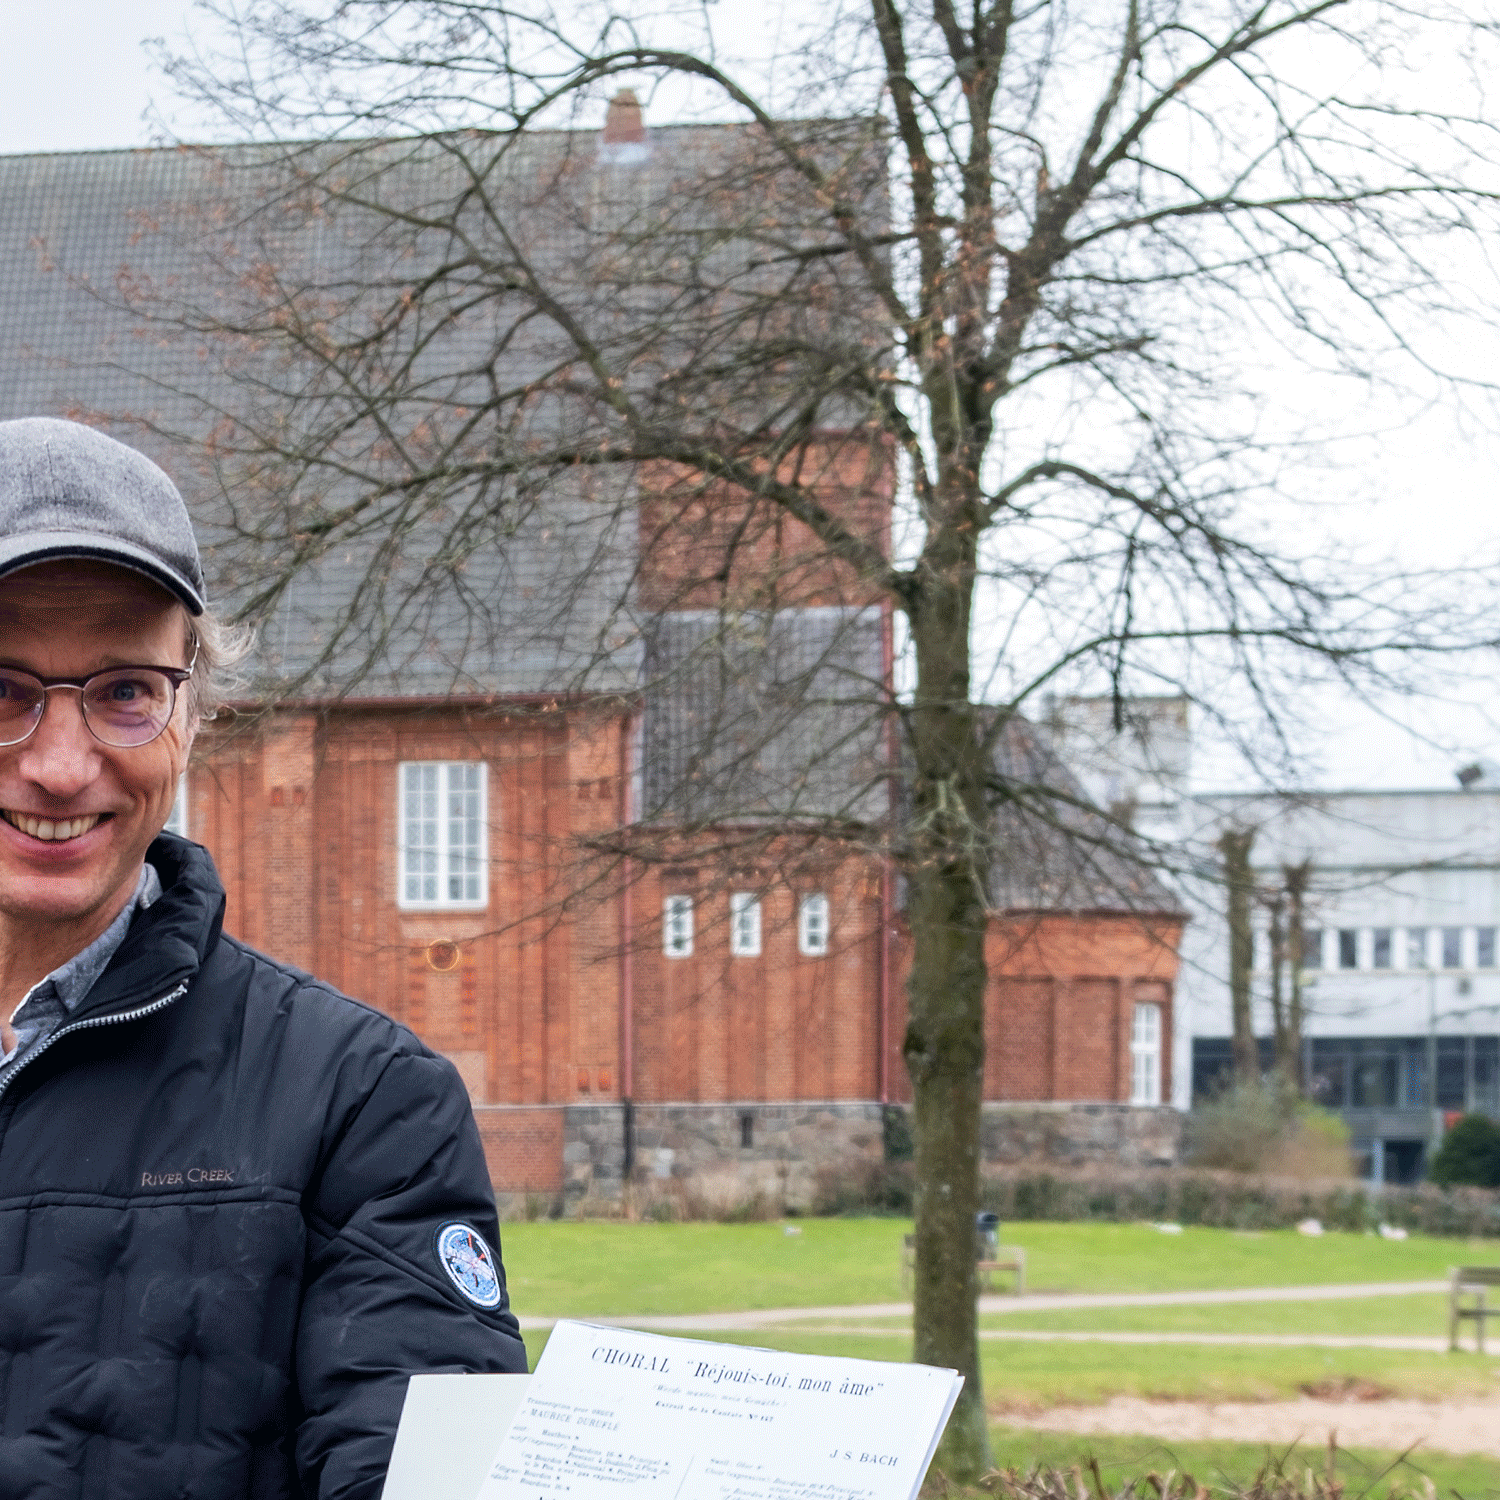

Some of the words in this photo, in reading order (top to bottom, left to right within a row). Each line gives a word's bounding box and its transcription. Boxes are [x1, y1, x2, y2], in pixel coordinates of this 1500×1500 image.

[141, 1172, 184, 1187] RIVER
[187, 1168, 235, 1183] CREEK
[592, 1348, 669, 1373] CHORAL
[798, 1378, 832, 1392] mon
[859, 1453, 898, 1466] BACH
